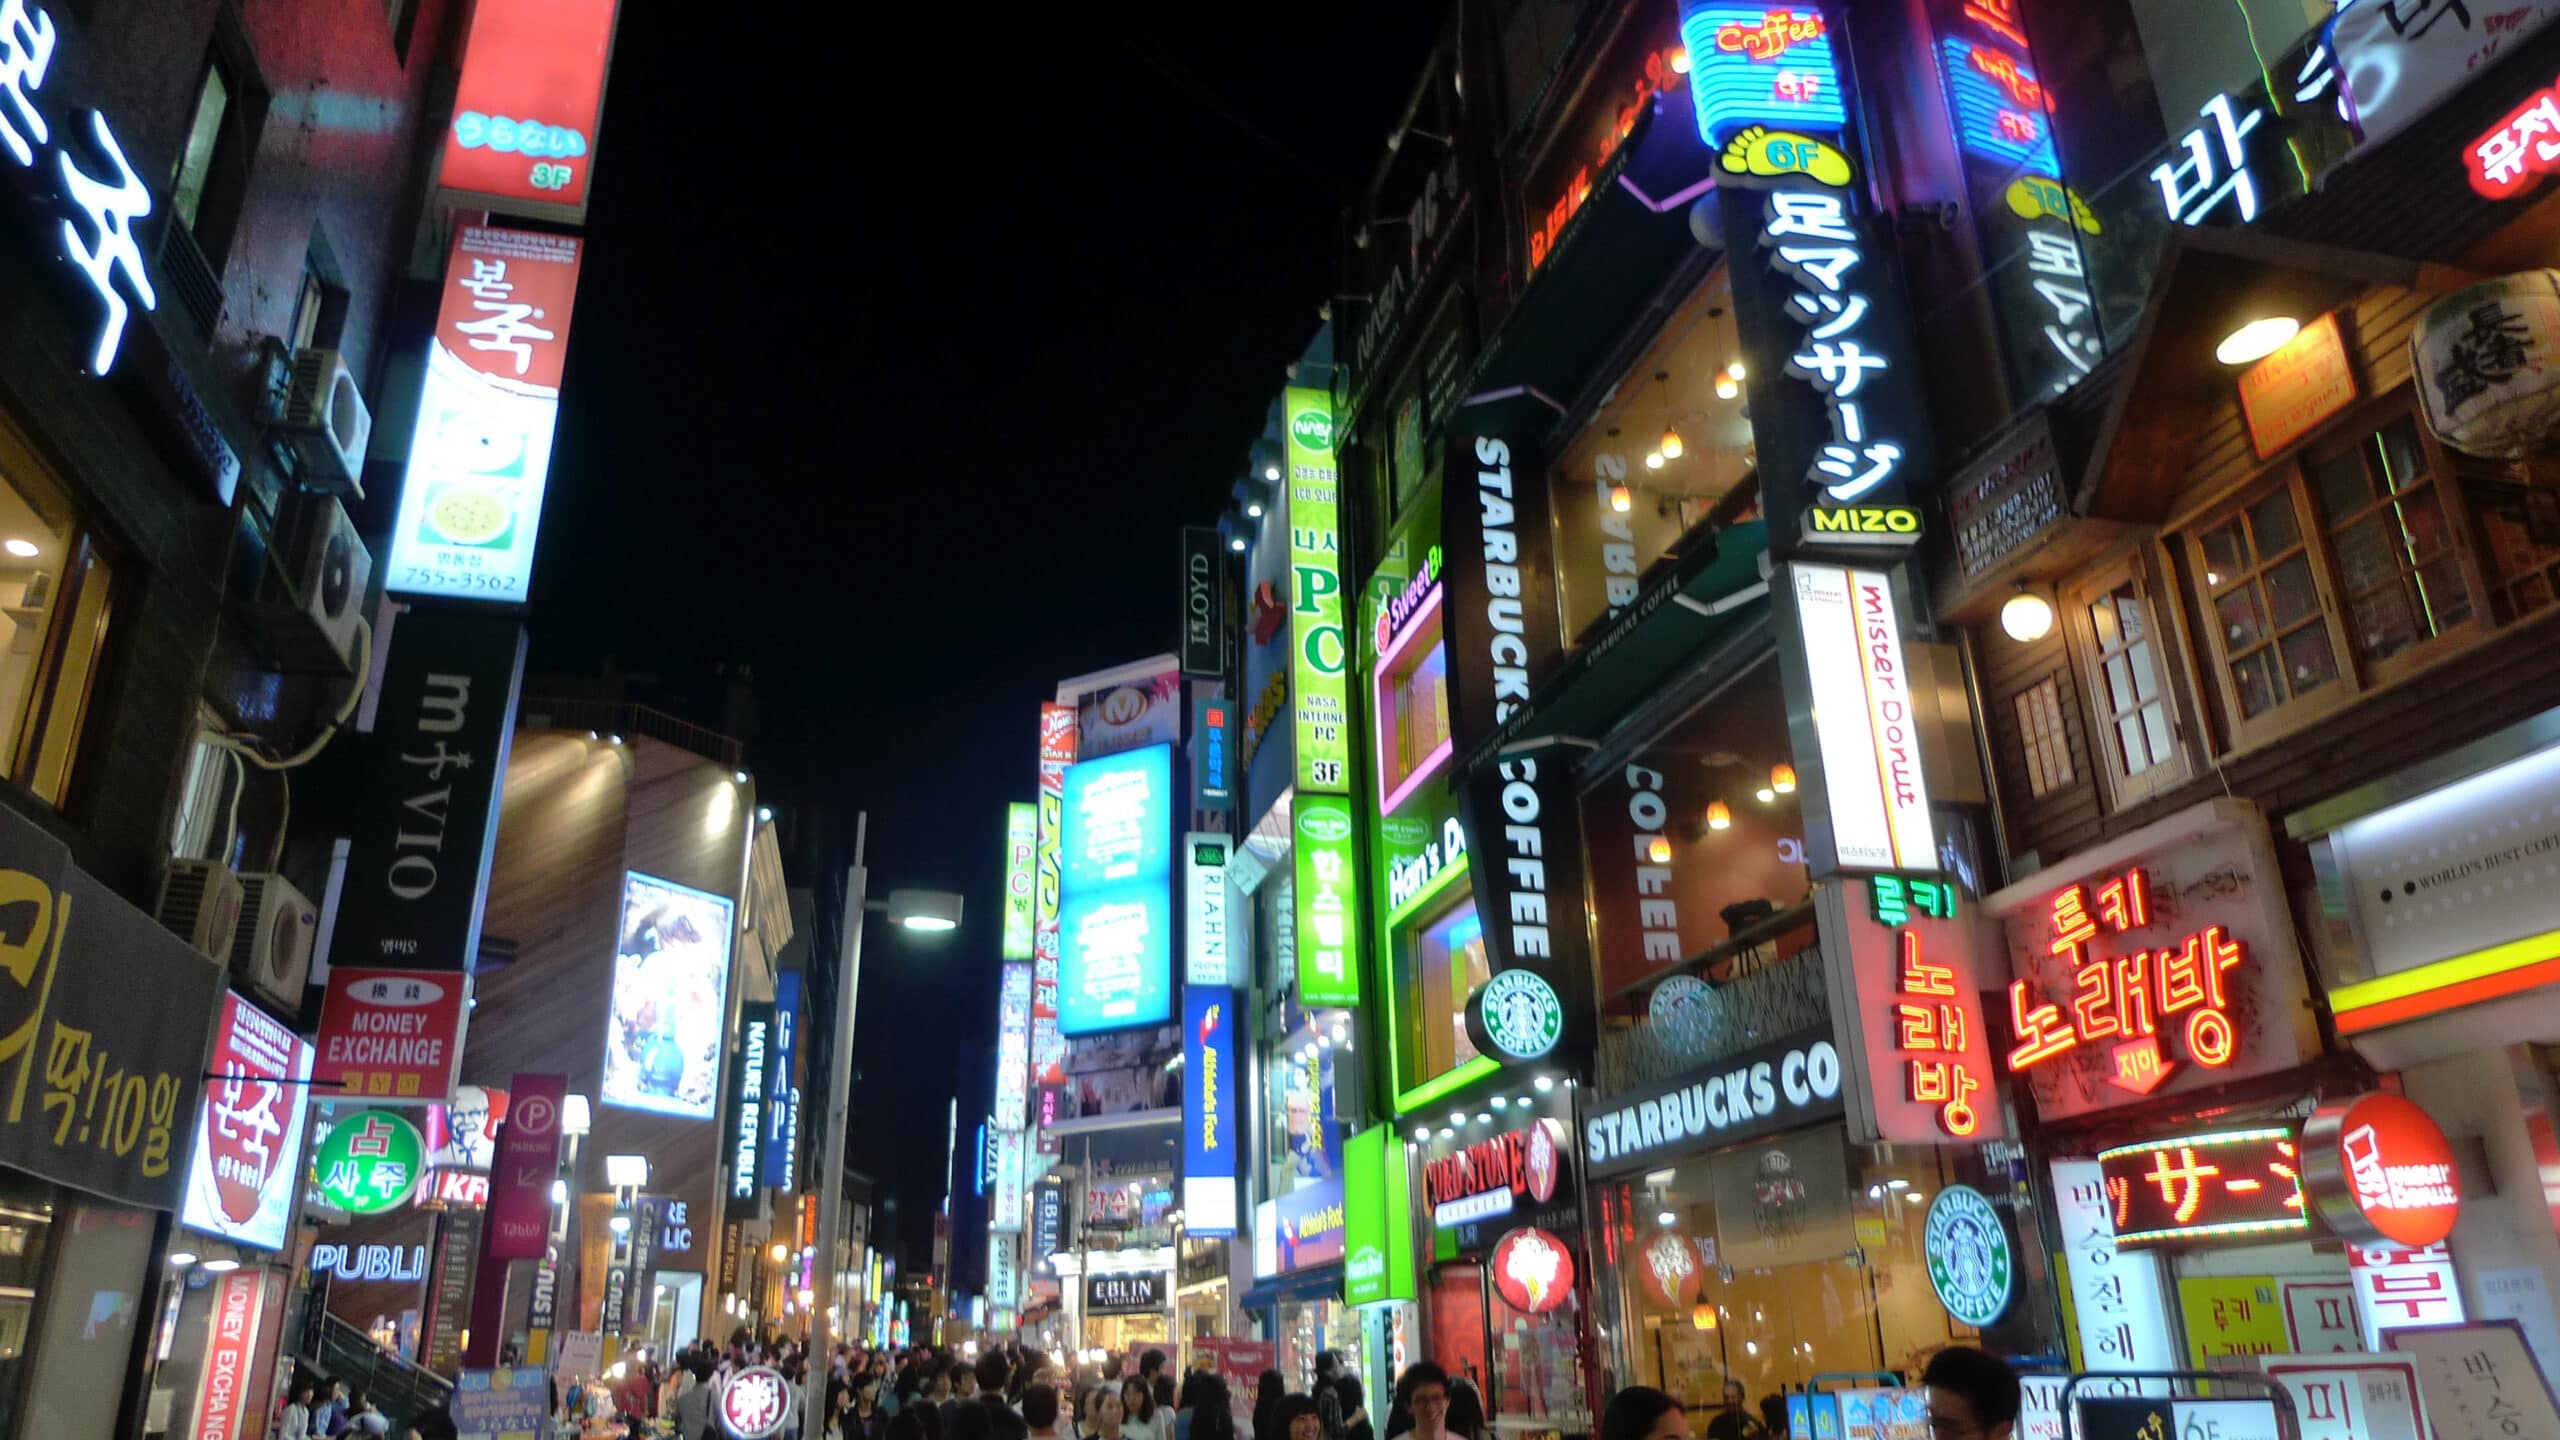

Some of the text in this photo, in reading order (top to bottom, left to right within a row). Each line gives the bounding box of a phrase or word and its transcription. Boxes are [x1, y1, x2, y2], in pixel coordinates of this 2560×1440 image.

[1717, 13, 1820, 60] Coffee
[456, 109, 586, 158] うらない
[1765, 139, 1820, 170] 6F
[530, 162, 572, 190] 3F
[456, 258, 555, 374] 본죽
[1769, 190, 1901, 505] 足マッサージ
[1813, 507, 1918, 532] MIZO
[1190, 552, 1210, 646] LLOYD
[1390, 544, 1442, 632] SweetB
[1474, 435, 1531, 727] STARBUCKS
[1306, 694, 1336, 708] NASA
[1314, 725, 1336, 742] PC
[1881, 700, 1914, 809] Donut
[1312, 760, 1342, 784] 3F
[1389, 816, 1467, 911] Han's D
[1499, 756, 1552, 959] COFFEE
[2418, 858, 2483, 890] WORLD'S
[2484, 846, 2521, 871] BEST
[1204, 873, 1222, 956] RIAHN
[1485, 972, 1555, 1013] STARBUCKS
[2006, 924, 2241, 1072] 노래방
[352, 1011, 427, 1035] MONEY
[1496, 1028, 1552, 1055] COFFEE
[1900, 928, 1979, 1138] 노래방
[327, 1035, 443, 1067] EXCHANGE
[770, 1010, 792, 1140] GAP
[2119, 1050, 2161, 1083] 지하
[42, 1020, 181, 1178] 딱!10일
[215, 1059, 284, 1193] 본죽
[733, 1021, 766, 1198] NATURE REPUBLIC
[1586, 1061, 1775, 1165] STARBUCKS
[349, 1116, 394, 1158] 占
[441, 1172, 489, 1202] KF
[1929, 1187, 2009, 1255] STARBUCKS
[312, 1245, 426, 1281] PUBLI
[996, 1238, 1009, 1299] COFFEE
[1095, 1279, 1152, 1298] EBLIN
[1944, 1281, 2002, 1323] COFFEE
[203, 1275, 250, 1440] MONEY EXCHANG
